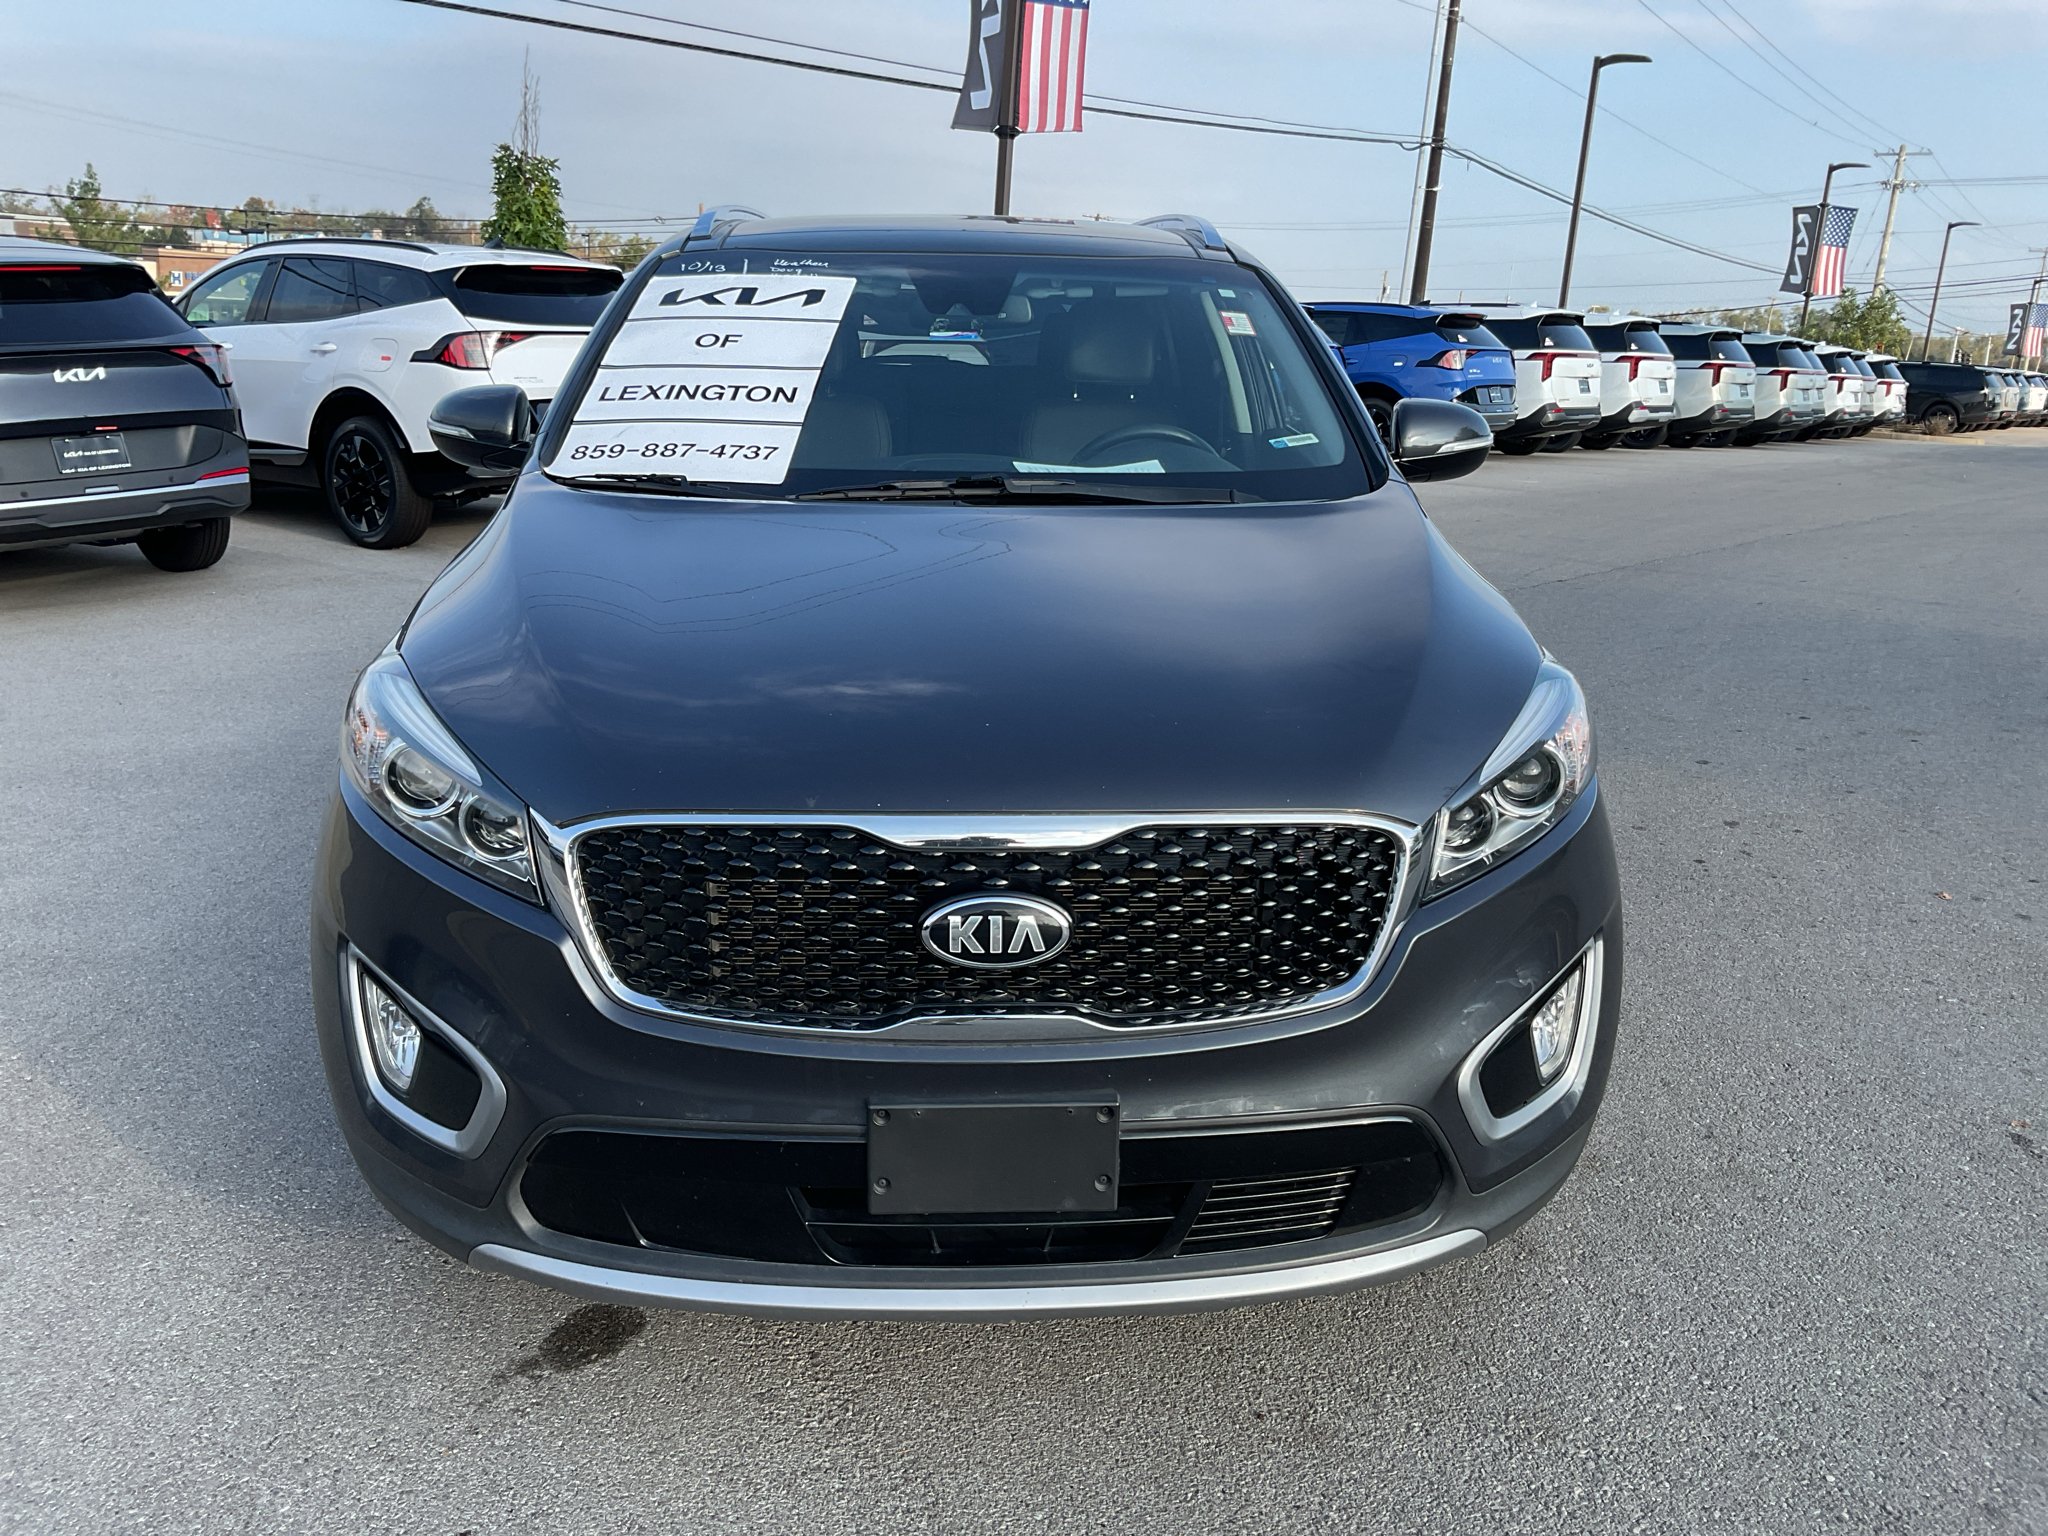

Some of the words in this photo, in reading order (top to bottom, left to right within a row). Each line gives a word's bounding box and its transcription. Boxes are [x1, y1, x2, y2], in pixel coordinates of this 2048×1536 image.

[681, 261, 726, 273] 10/13
[659, 287, 826, 308] KIA
[695, 334, 743, 348] OF
[53, 366, 107, 383] KIA
[598, 384, 799, 403] LEXINGTON
[571, 443, 780, 461] 859-887-4737
[947, 915, 1046, 953] KIA
